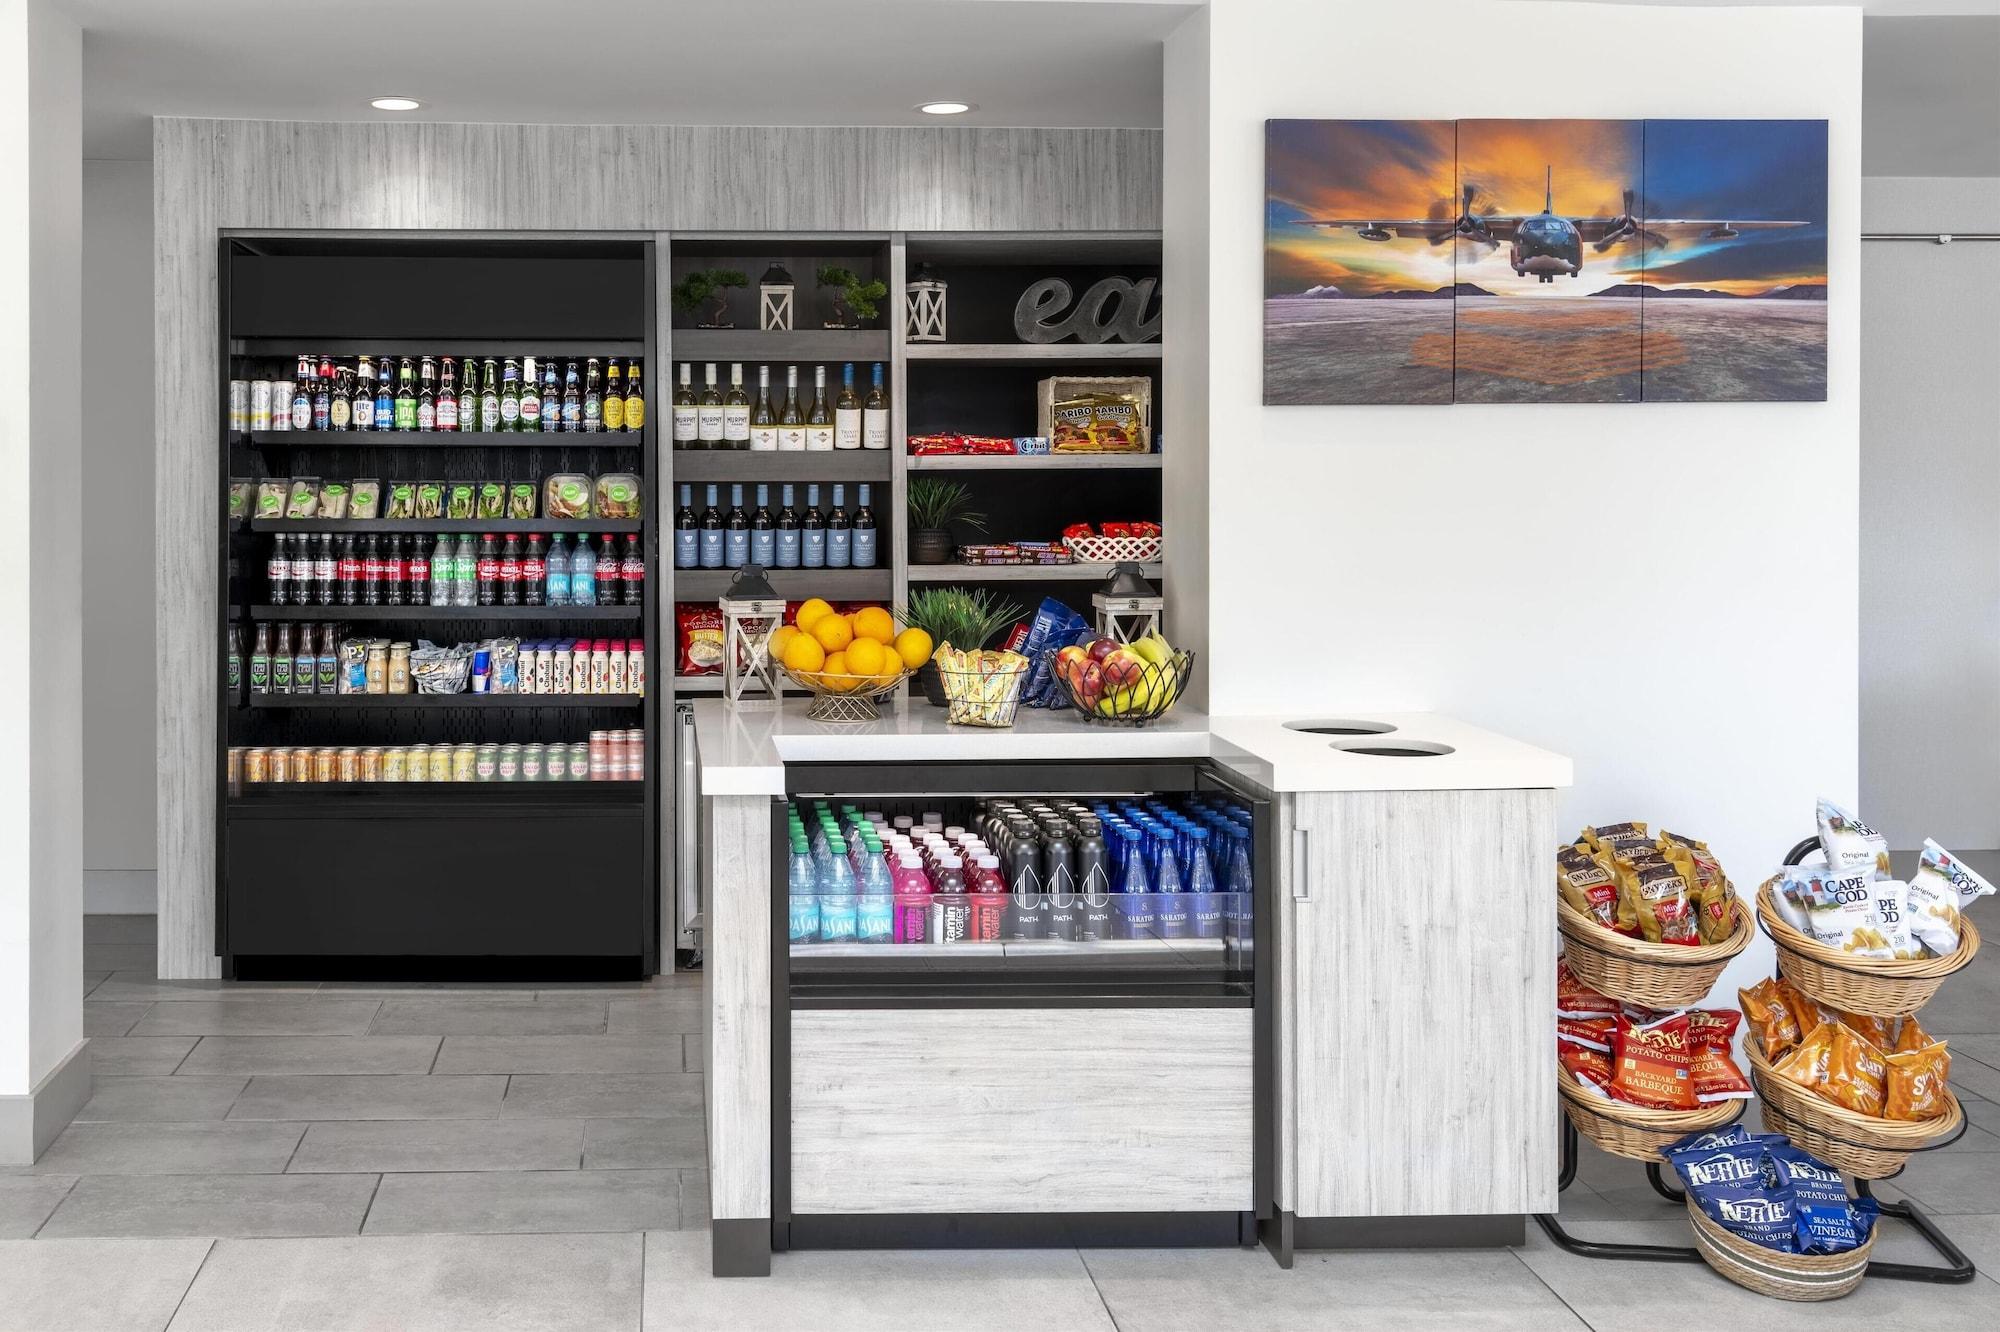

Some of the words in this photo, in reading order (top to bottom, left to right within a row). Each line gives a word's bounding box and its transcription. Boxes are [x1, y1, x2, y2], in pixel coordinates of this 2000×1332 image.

[355, 402, 369, 411] Lite
[400, 407, 413, 420] IPA
[347, 645, 365, 659] P3
[499, 645, 515, 659] P3
[1825, 877, 1865, 893] CAPE
[1952, 873, 1973, 895] COD
[1593, 888, 1611, 898] Mini
[1834, 889, 1868, 905] COD
[1911, 885, 1939, 900] Original
[955, 907, 964, 938] water
[991, 908, 1000, 939] water
[1089, 913, 1108, 921] PATH
[859, 915, 890, 936] ASANI
[944, 906, 956, 944] tamin
[1817, 931, 1843, 939] Original
[1626, 1045, 1662, 1058] POTATO
[1665, 1054, 1689, 1063] CHIPS
[1635, 1070, 1677, 1084] BACKYARD
[1625, 1076, 1684, 1094] BARBEQUE
[1684, 1153, 1759, 1186] KETTLE
[1796, 1190, 1827, 1200] POTATO
[1716, 1198, 1791, 1223] KETTLE
[1828, 1218, 1844, 1226] SALT
[1766, 1232, 1792, 1241] CHIPS
